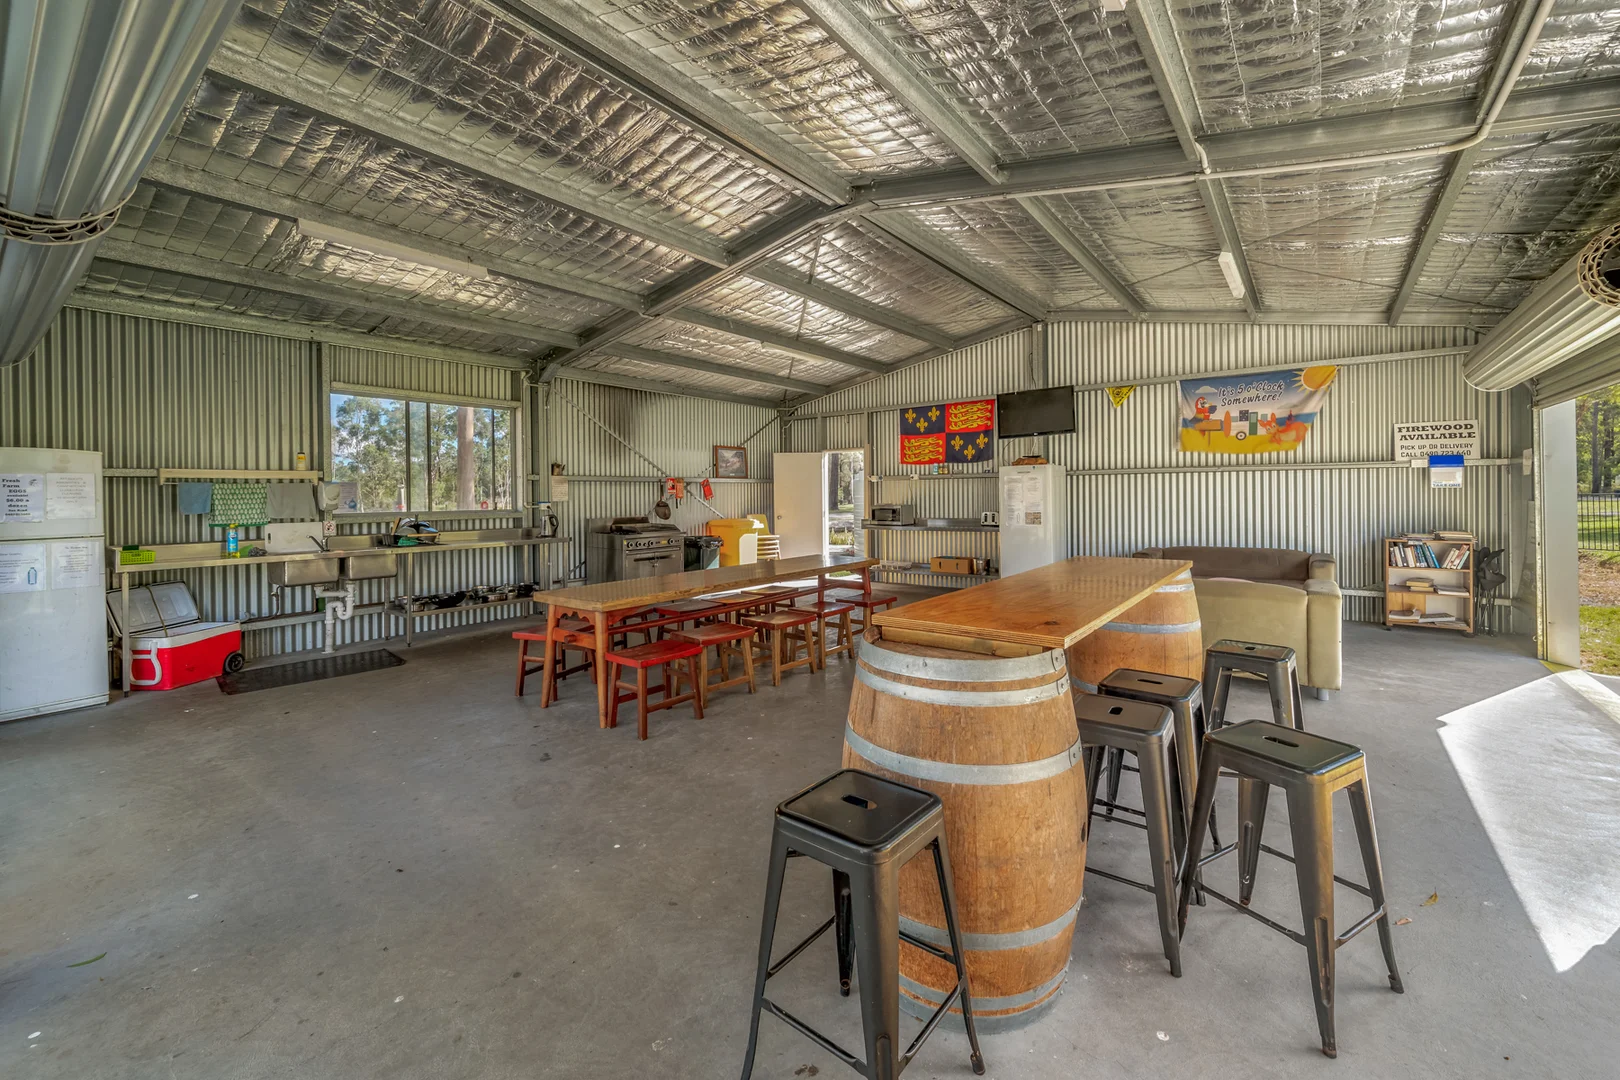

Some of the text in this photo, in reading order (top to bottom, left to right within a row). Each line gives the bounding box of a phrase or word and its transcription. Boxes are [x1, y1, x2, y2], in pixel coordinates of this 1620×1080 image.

[1218, 380, 1284, 398] It's 5 o'Clock
[1221, 391, 1283, 407] Somewhere!
[1397, 423, 1474, 432] FIREWOOD
[1399, 432, 1476, 440] AVAILABLE
